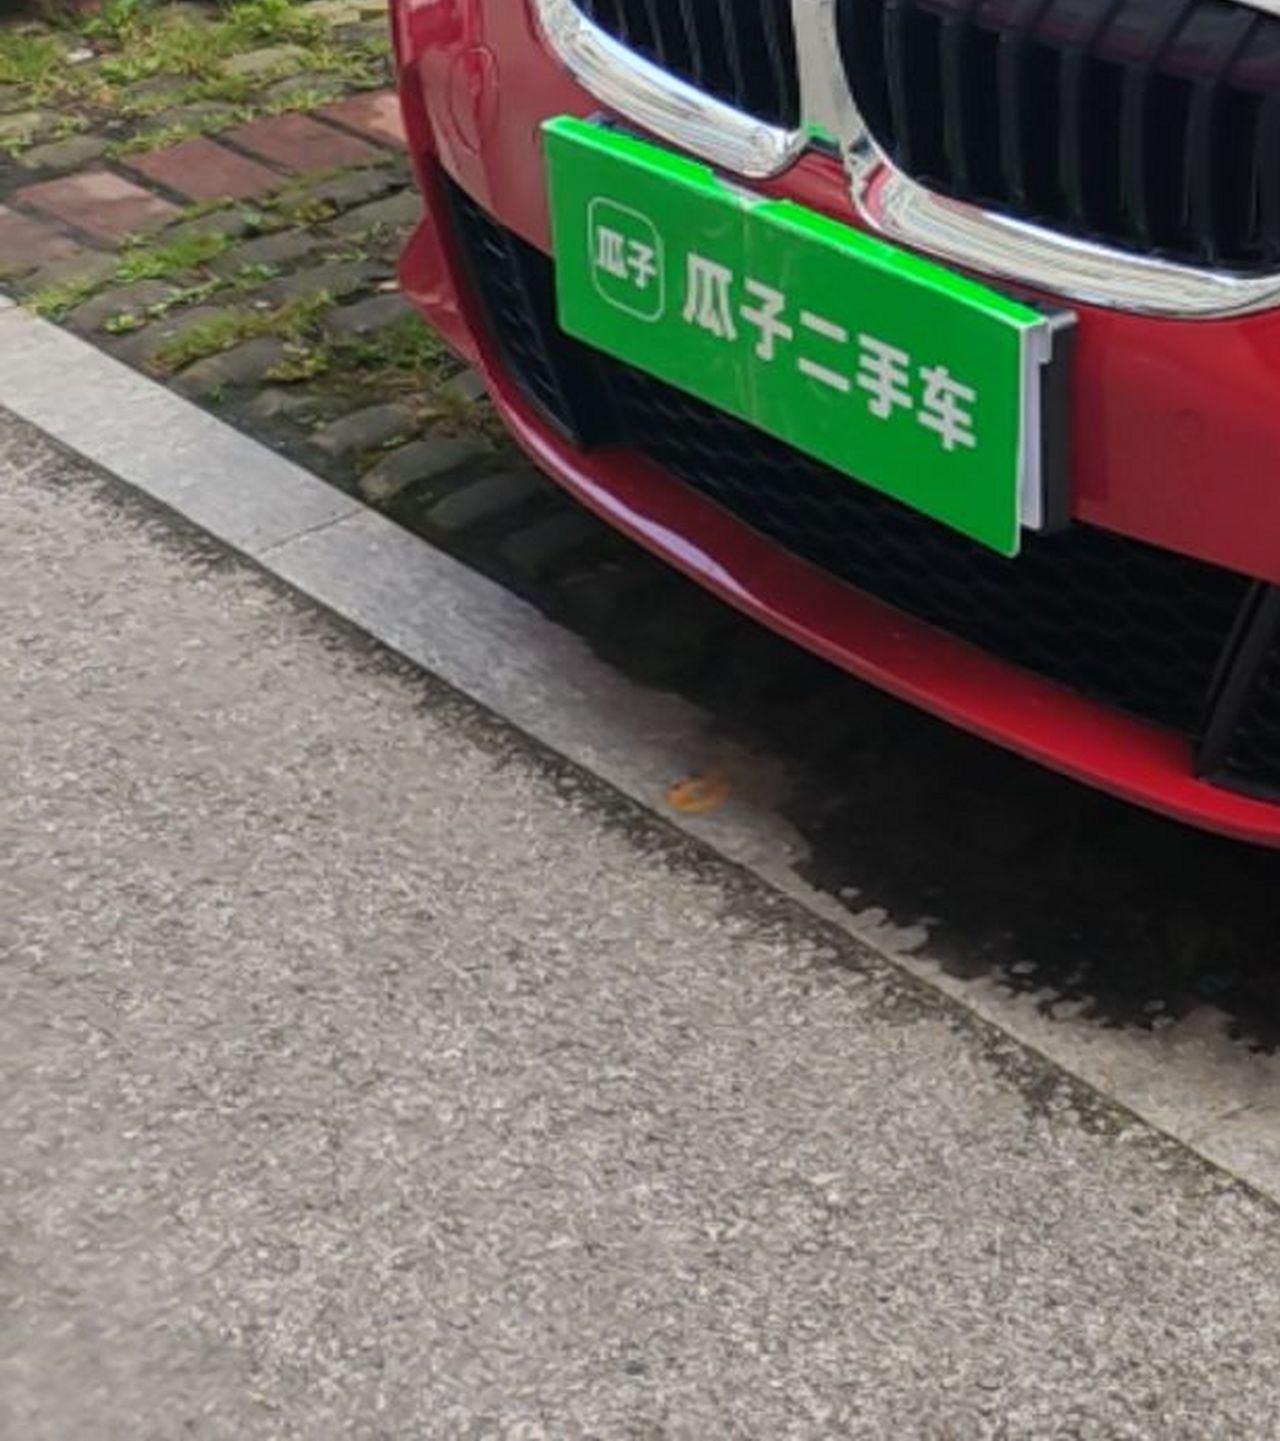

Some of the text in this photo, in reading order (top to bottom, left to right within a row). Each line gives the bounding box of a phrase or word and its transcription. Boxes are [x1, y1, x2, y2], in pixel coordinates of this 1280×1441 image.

[596, 225, 656, 289] 瓜子
[683, 252, 976, 451] 瓜子二手车
